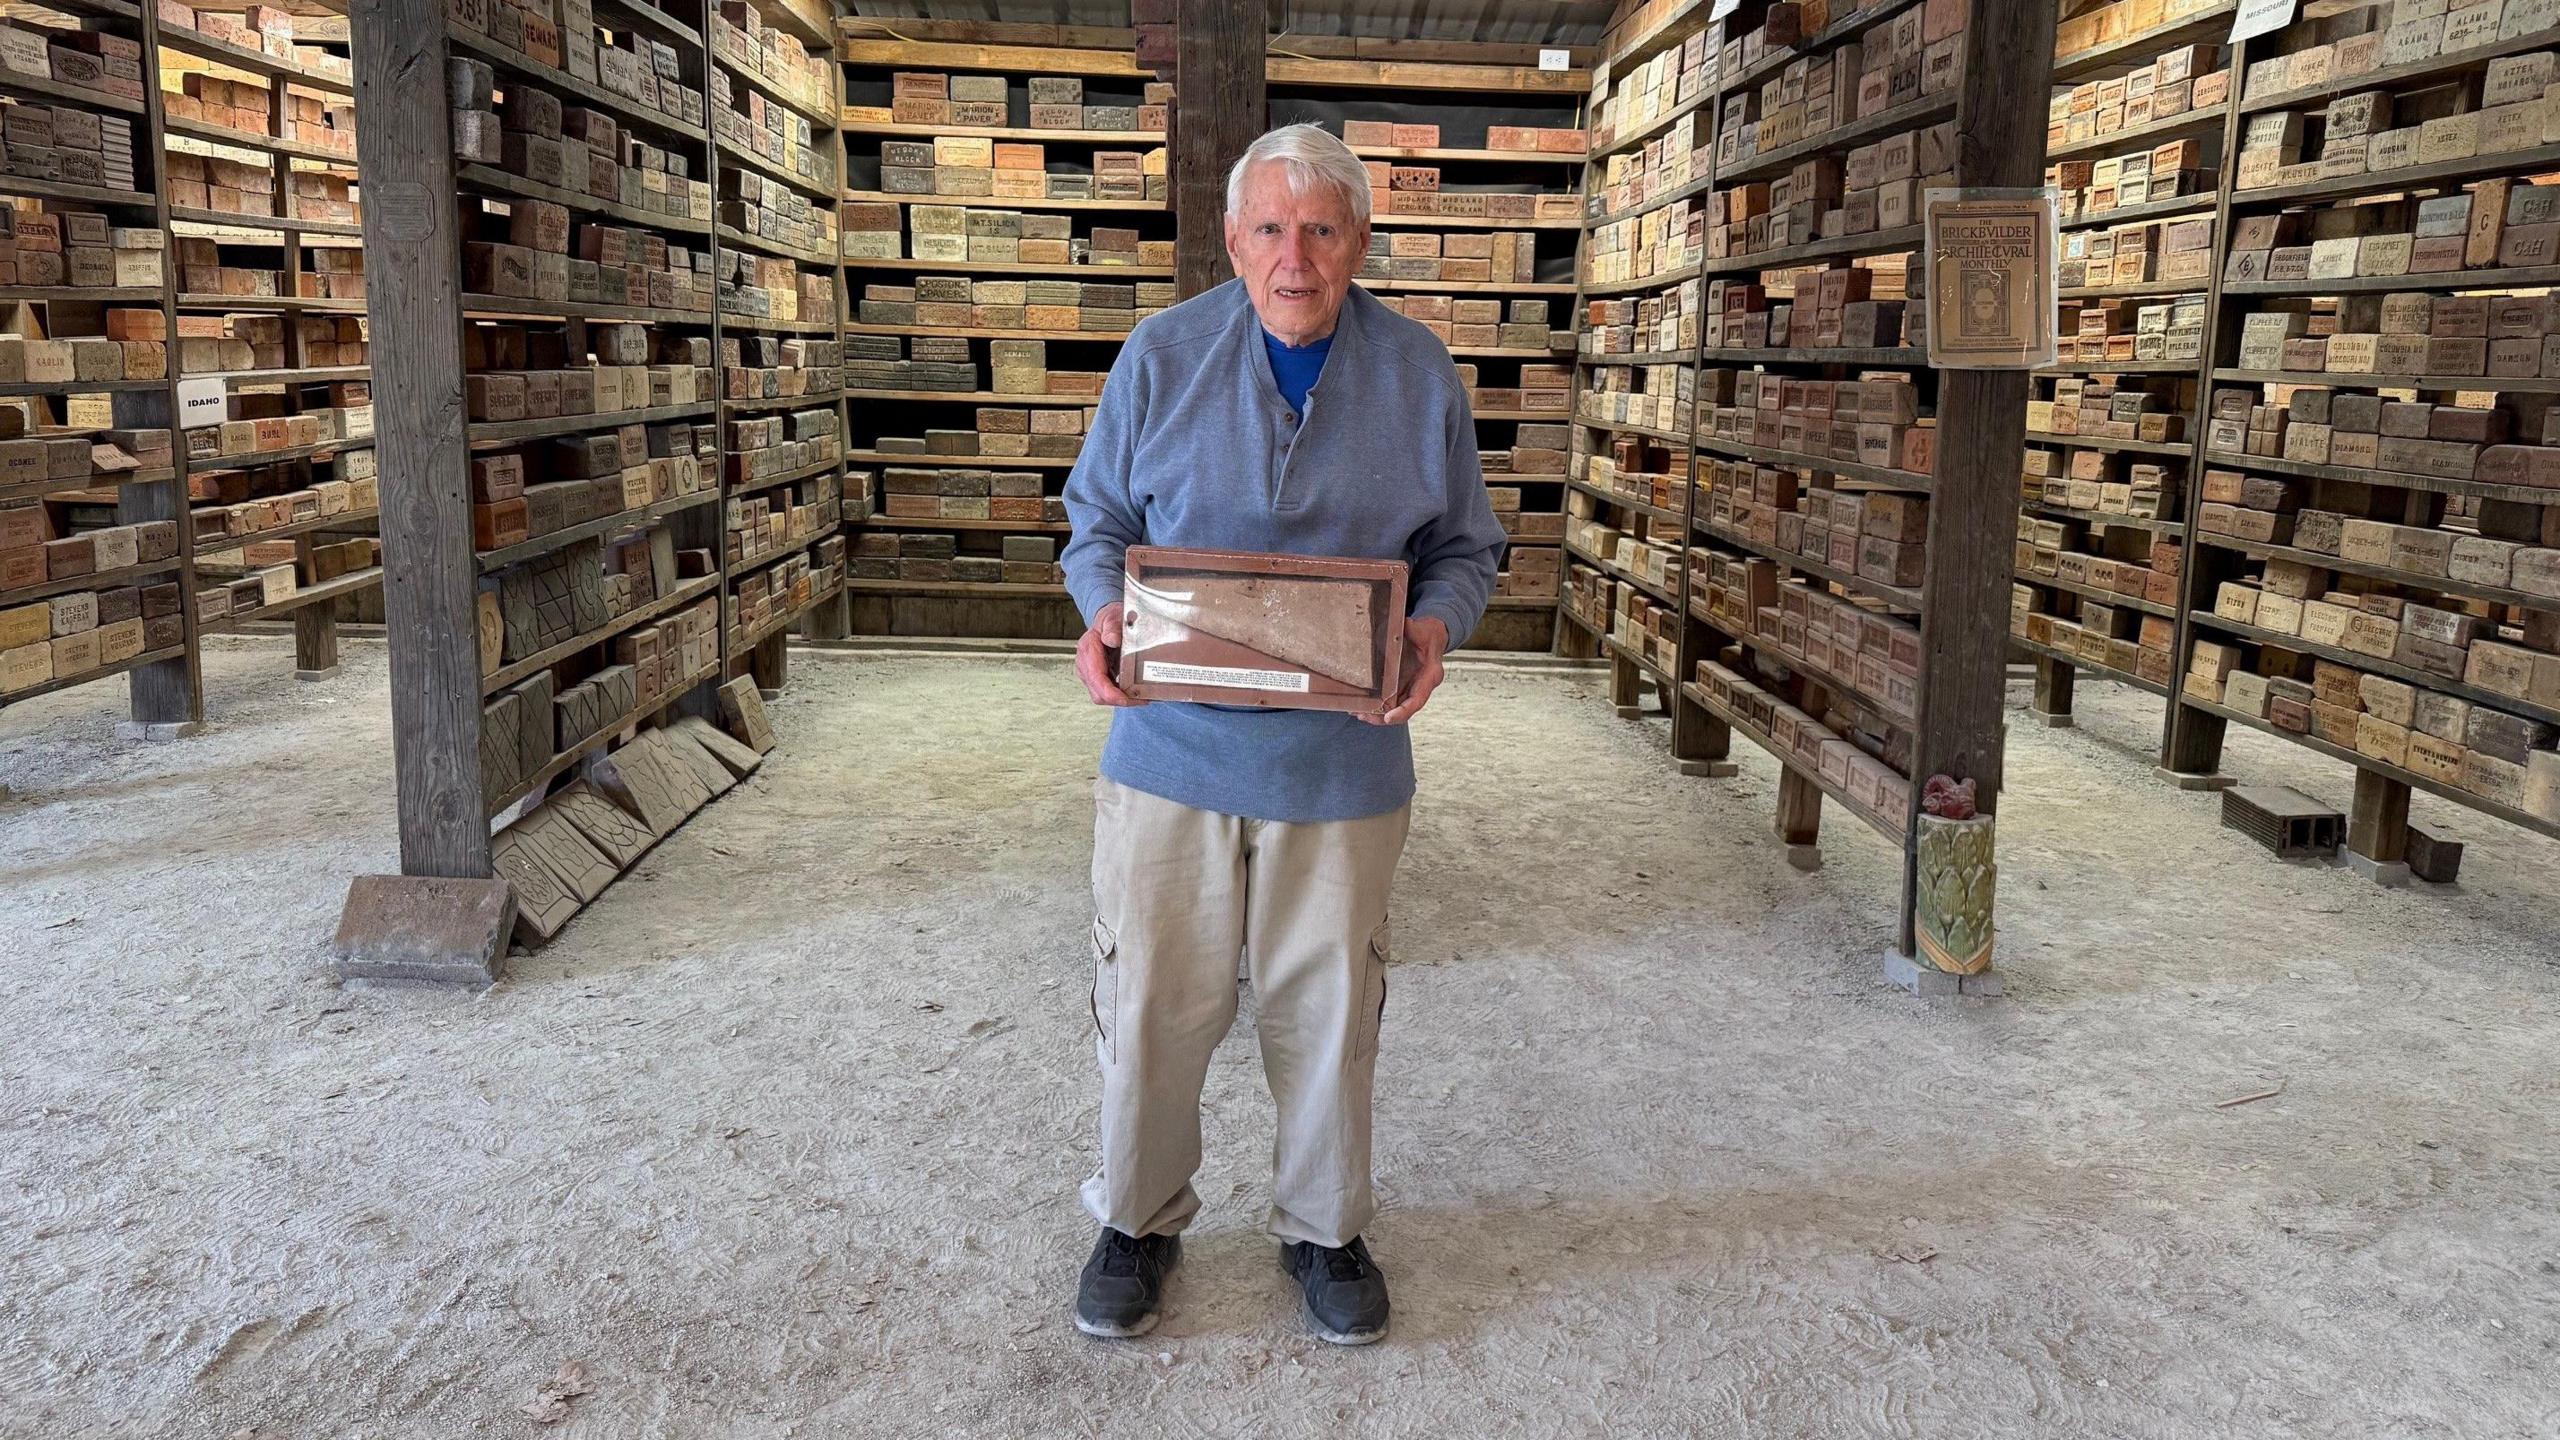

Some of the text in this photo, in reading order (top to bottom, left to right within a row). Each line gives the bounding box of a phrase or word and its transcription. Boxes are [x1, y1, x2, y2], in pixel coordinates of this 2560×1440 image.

[2245, 0, 2289, 20] MISSOURI
[2456, 11, 2488, 26] ALAMO
[904, 102, 938, 111] MARION
[961, 106, 993, 114] MARION
[907, 111, 935, 121] PAVER
[963, 115, 991, 123] PAVER
[2242, 162, 2273, 173] ALUSITE
[2281, 167, 2318, 179] ALUSITE
[2481, 214, 2489, 230] C
[1942, 226, 2032, 238] BRICKBVILDER
[1960, 259, 2012, 269] MONTHLY
[926, 280, 960, 288] POSTON
[927, 290, 960, 298] PAVER
[2333, 342, 2368, 351] COLUMBIA
[188, 397, 219, 407] IDAHO
[2290, 437, 2326, 448] DIALITE
[2335, 444, 2371, 453] DIAMOND
[8, 458, 37, 467] OCONEE
[60, 603, 89, 617] STEVENS
